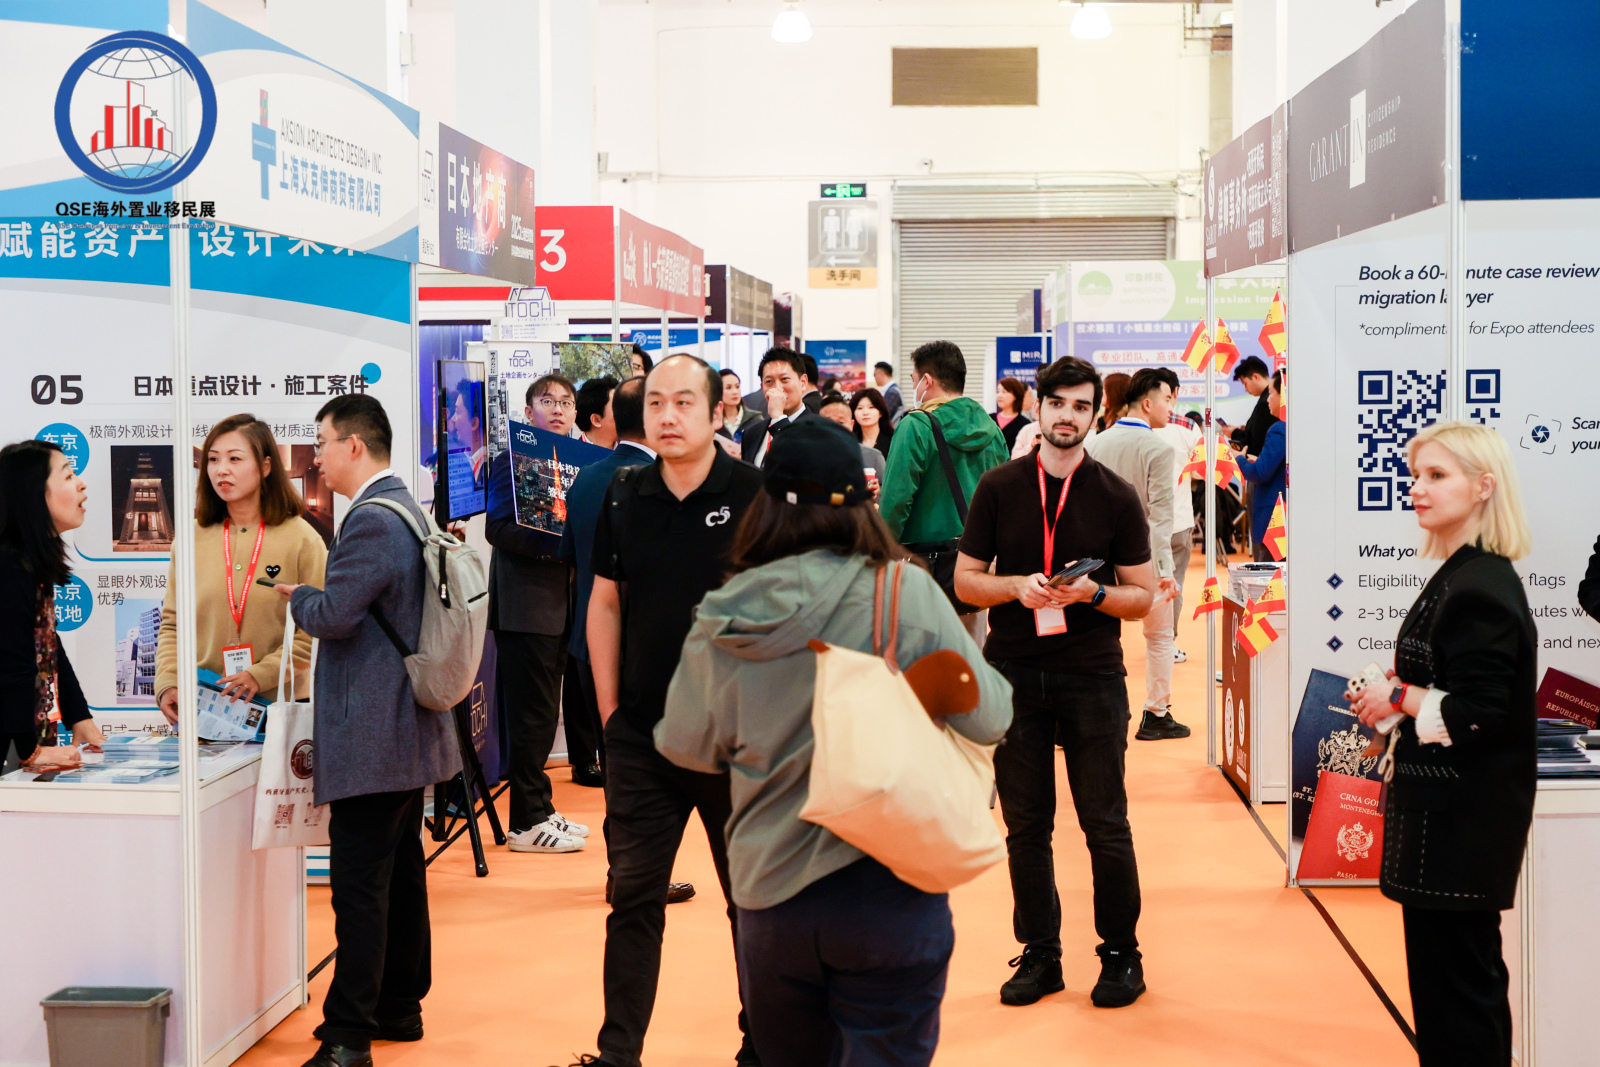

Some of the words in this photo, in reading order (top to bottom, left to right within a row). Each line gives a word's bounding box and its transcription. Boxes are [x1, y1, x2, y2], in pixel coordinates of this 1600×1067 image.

[307, 128, 345, 163] ARCHITECTS
[1367, 126, 1396, 154] RESIDENCE
[1309, 123, 1349, 182] GARANT
[447, 152, 507, 229] 日本地产商
[539, 228, 567, 273] 3
[826, 269, 861, 281] 洗手间
[1358, 265, 1401, 281] Book
[1404, 269, 1414, 280] a
[1506, 266, 1542, 279] case
[1546, 263, 1600, 279] review
[1358, 290, 1436, 309] migration
[508, 301, 556, 318] TOCHI
[1468, 321, 1488, 335] for
[1490, 321, 1524, 338] Expo
[1527, 320, 1595, 334] attendees
[508, 358, 534, 367] TOCHI
[30, 375, 84, 406] 05
[1358, 544, 1395, 558] What
[97, 575, 168, 589] 显眼外观设
[1358, 574, 1427, 591] Eligibility
[1528, 573, 1566, 590] flags
[97, 592, 125, 606] 优势
[1543, 635, 1573, 649] and
[1327, 704, 1358, 718] CARIBBEAN
[1545, 701, 1581, 721] REPUBLIK
[1339, 792, 1363, 806] CRNA
